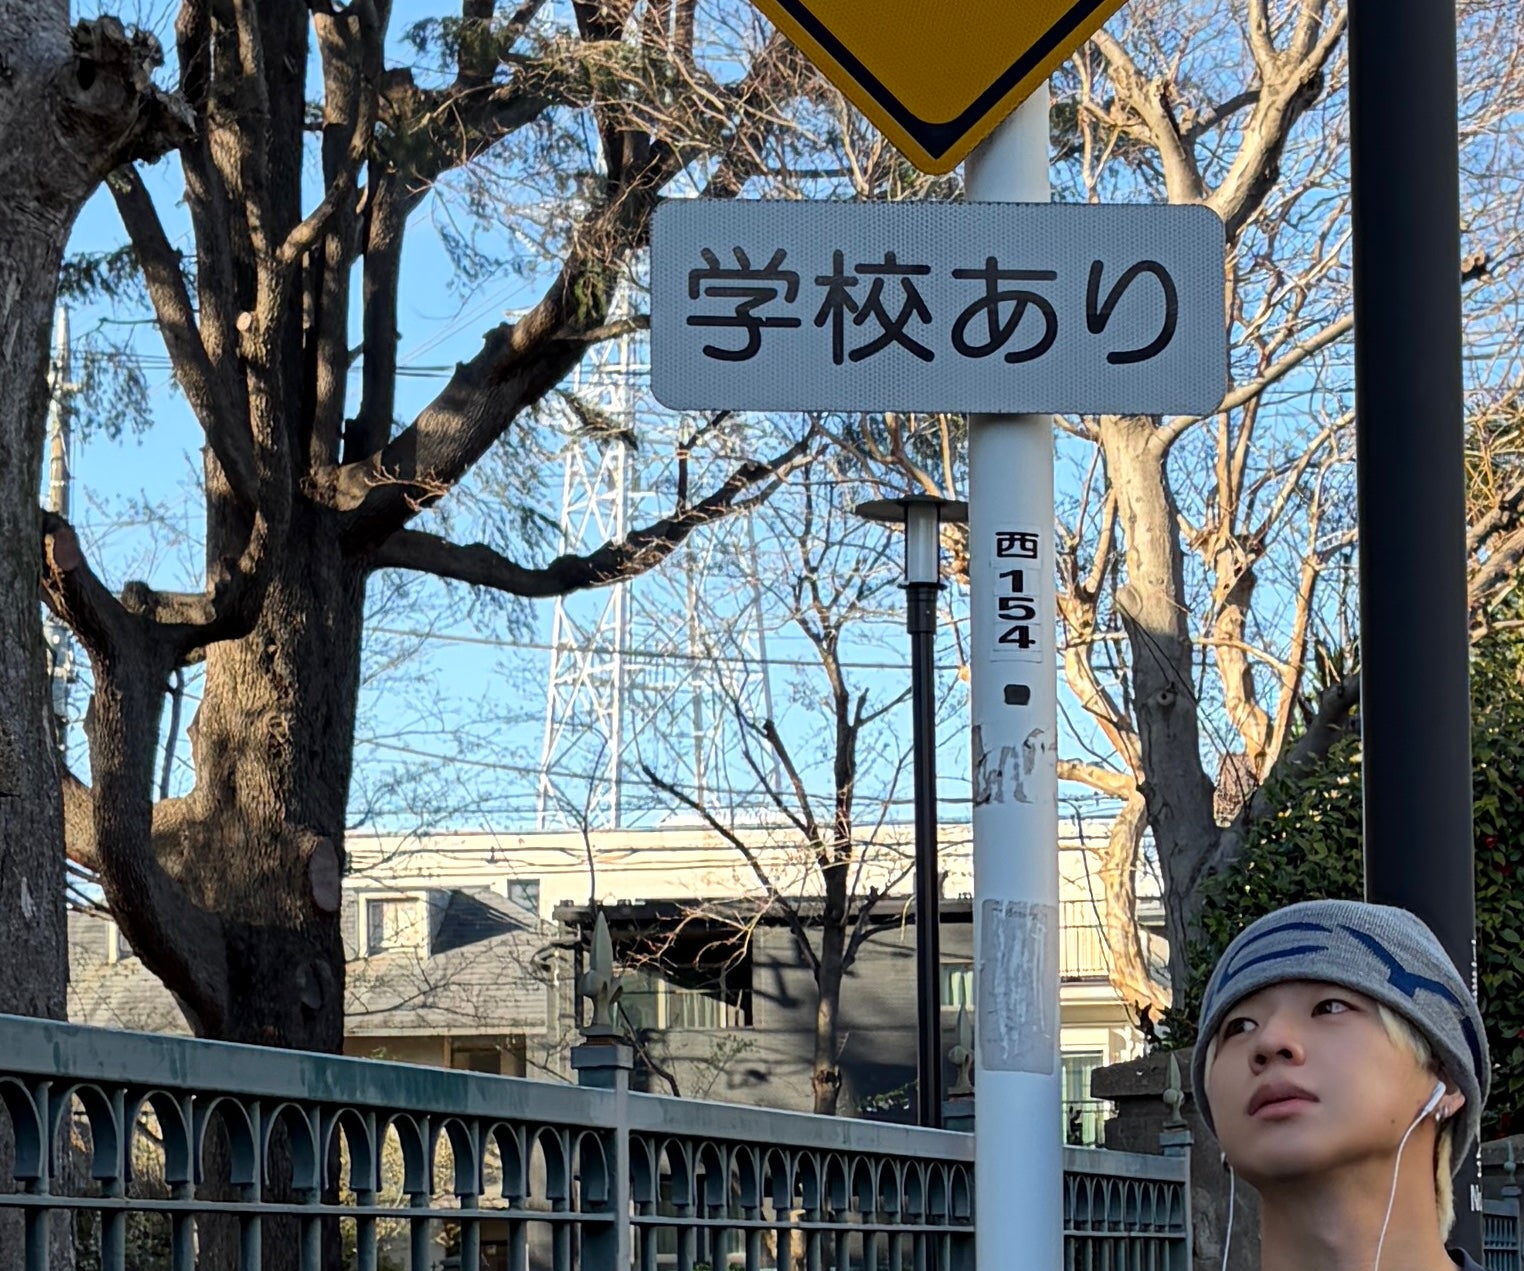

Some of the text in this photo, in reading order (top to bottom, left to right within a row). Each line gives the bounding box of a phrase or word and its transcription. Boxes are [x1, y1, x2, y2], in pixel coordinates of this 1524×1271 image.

[686, 246, 1179, 365] 学校あり
[994, 530, 1039, 650] 西154
